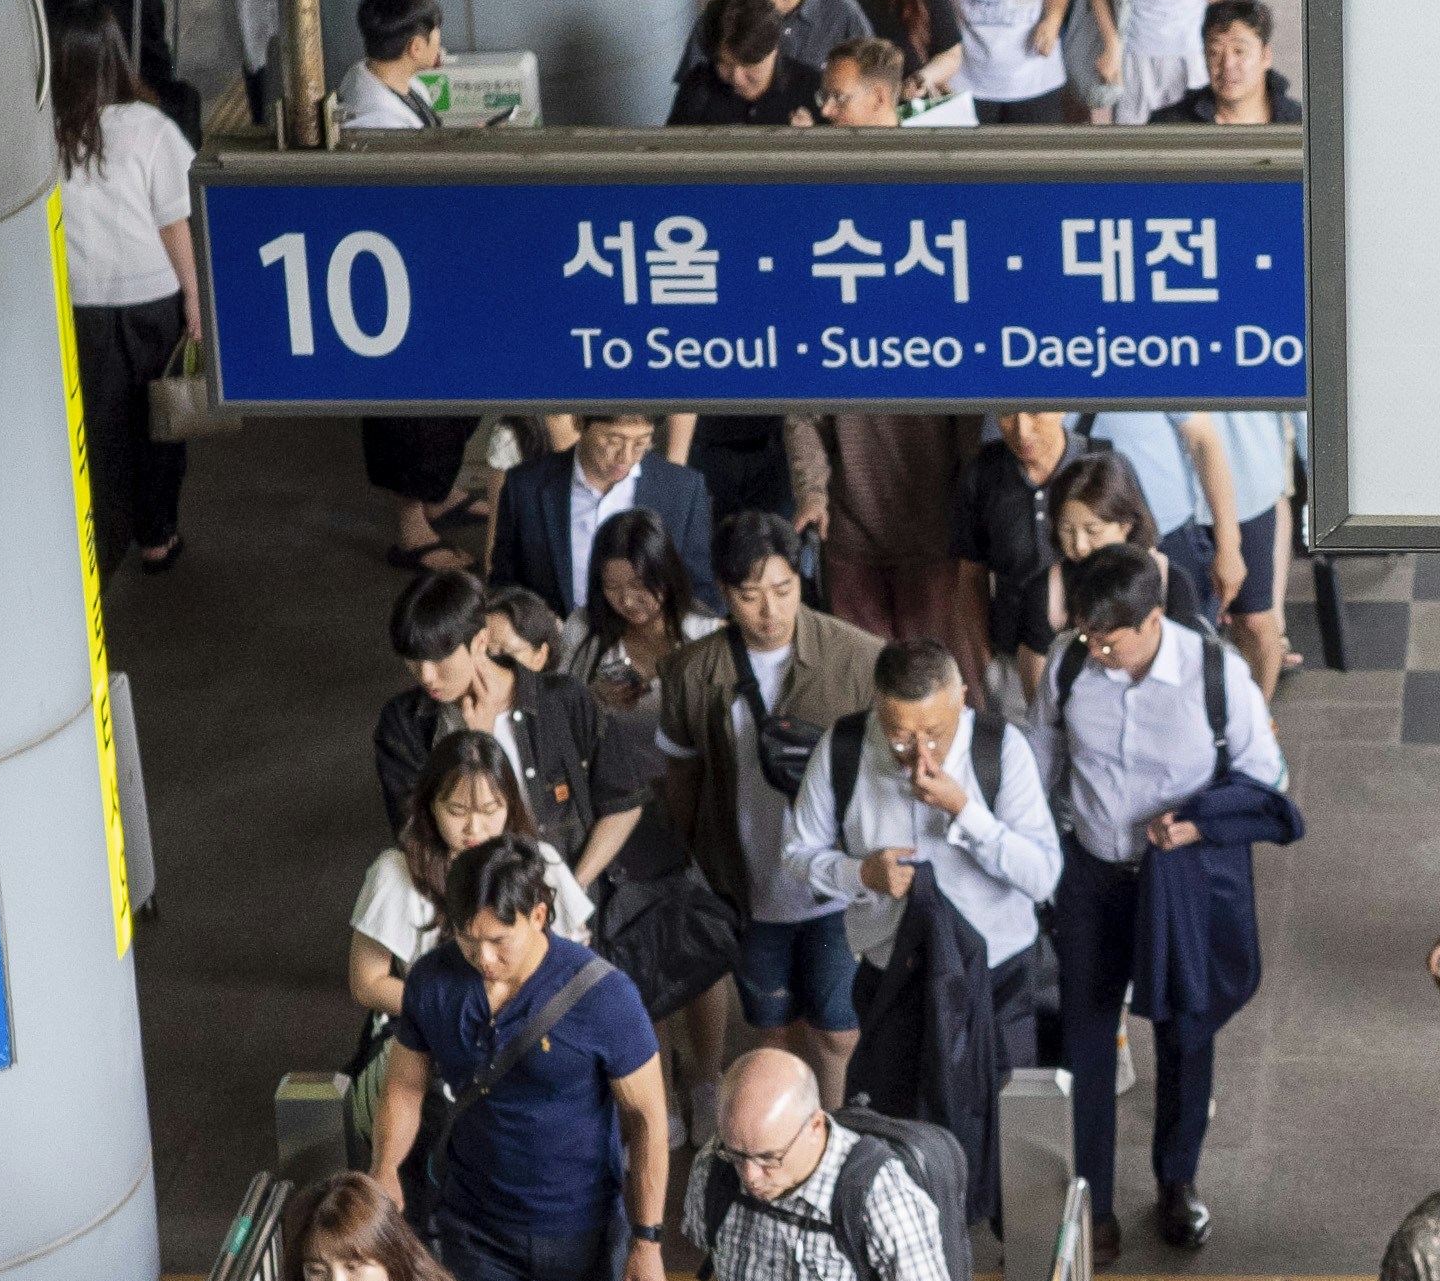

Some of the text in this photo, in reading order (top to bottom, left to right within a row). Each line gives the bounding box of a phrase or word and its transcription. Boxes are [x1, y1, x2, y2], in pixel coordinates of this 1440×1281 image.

[258, 230, 412, 358] 10
[563, 215, 1220, 305] 서울 수서 대전
[570, 328, 633, 369] To
[646, 325, 778, 370] Seoul
[820, 326, 964, 369] Suseo
[1000, 325, 1200, 379] Daejeon
